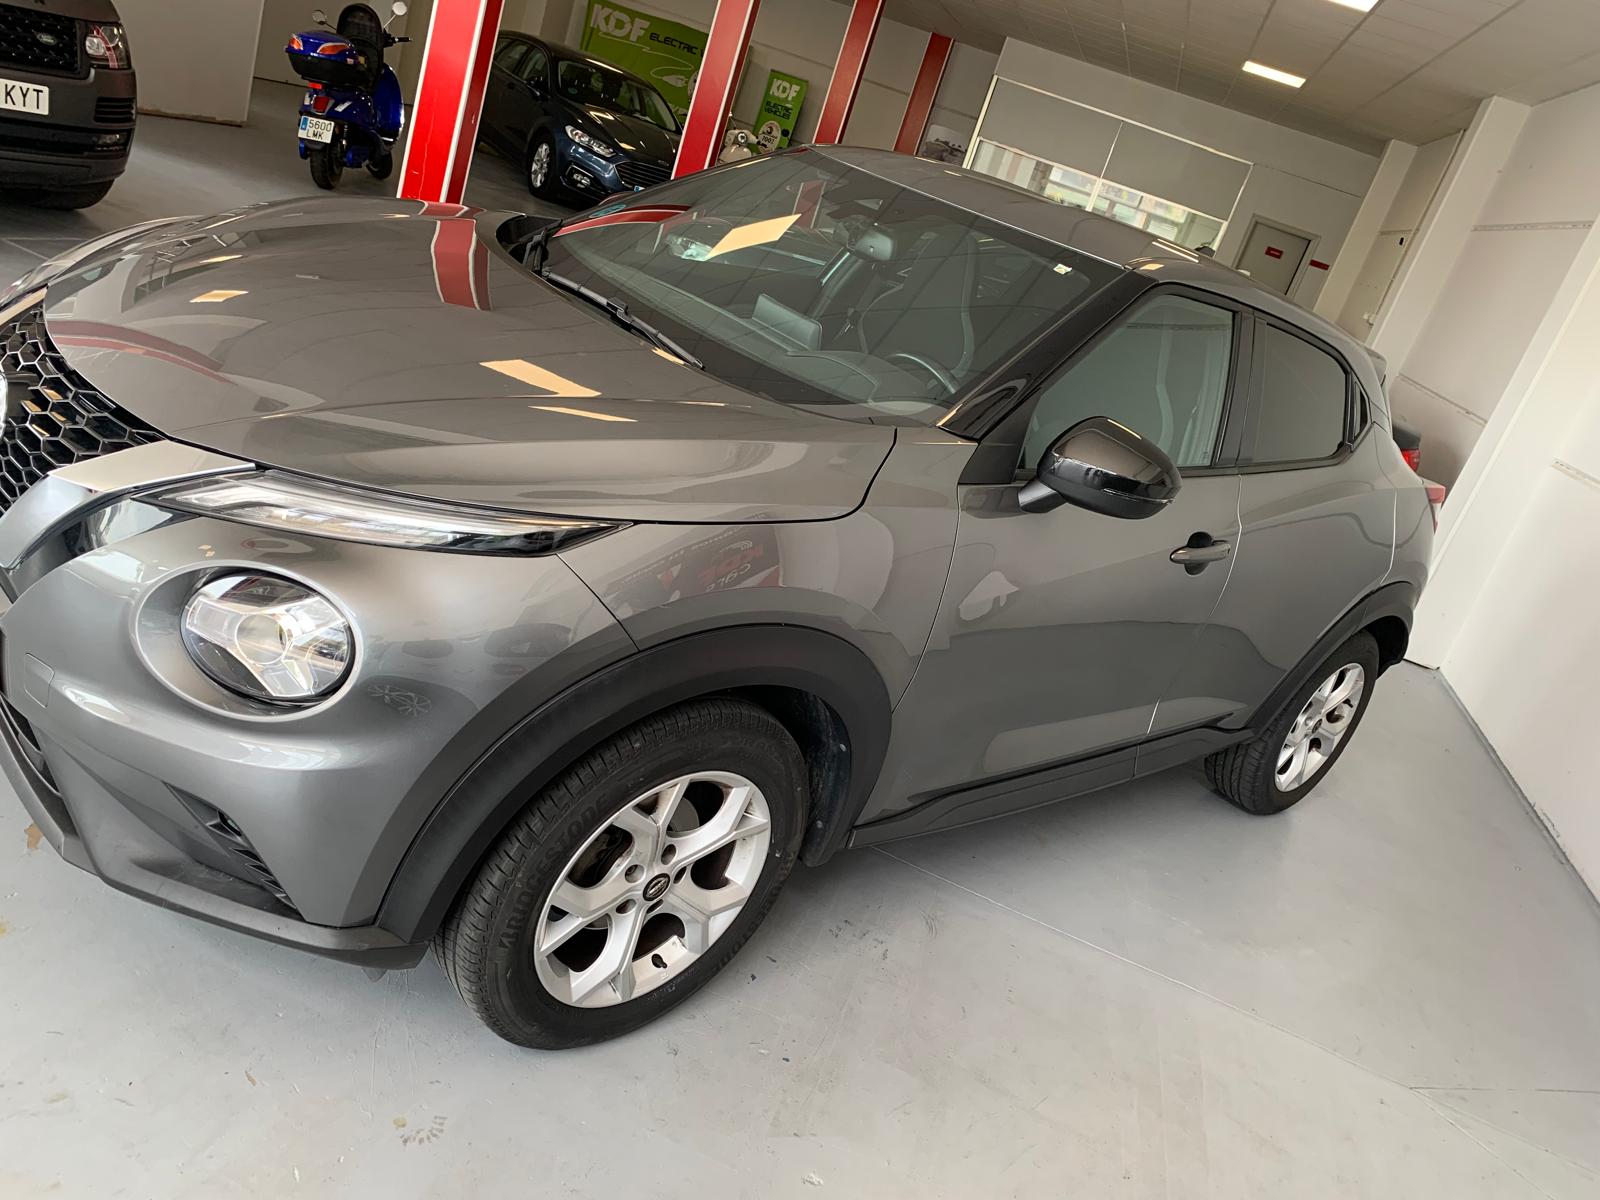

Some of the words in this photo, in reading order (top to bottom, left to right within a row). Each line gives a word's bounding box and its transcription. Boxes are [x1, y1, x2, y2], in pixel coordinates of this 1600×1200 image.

[590, 4, 651, 42] KDF
[649, 32, 698, 55] ELECTRIC
[4, 83, 44, 109] KYT
[769, 78, 801, 101] KDF
[306, 129, 324, 140] LMK
[308, 119, 332, 132] 5600
